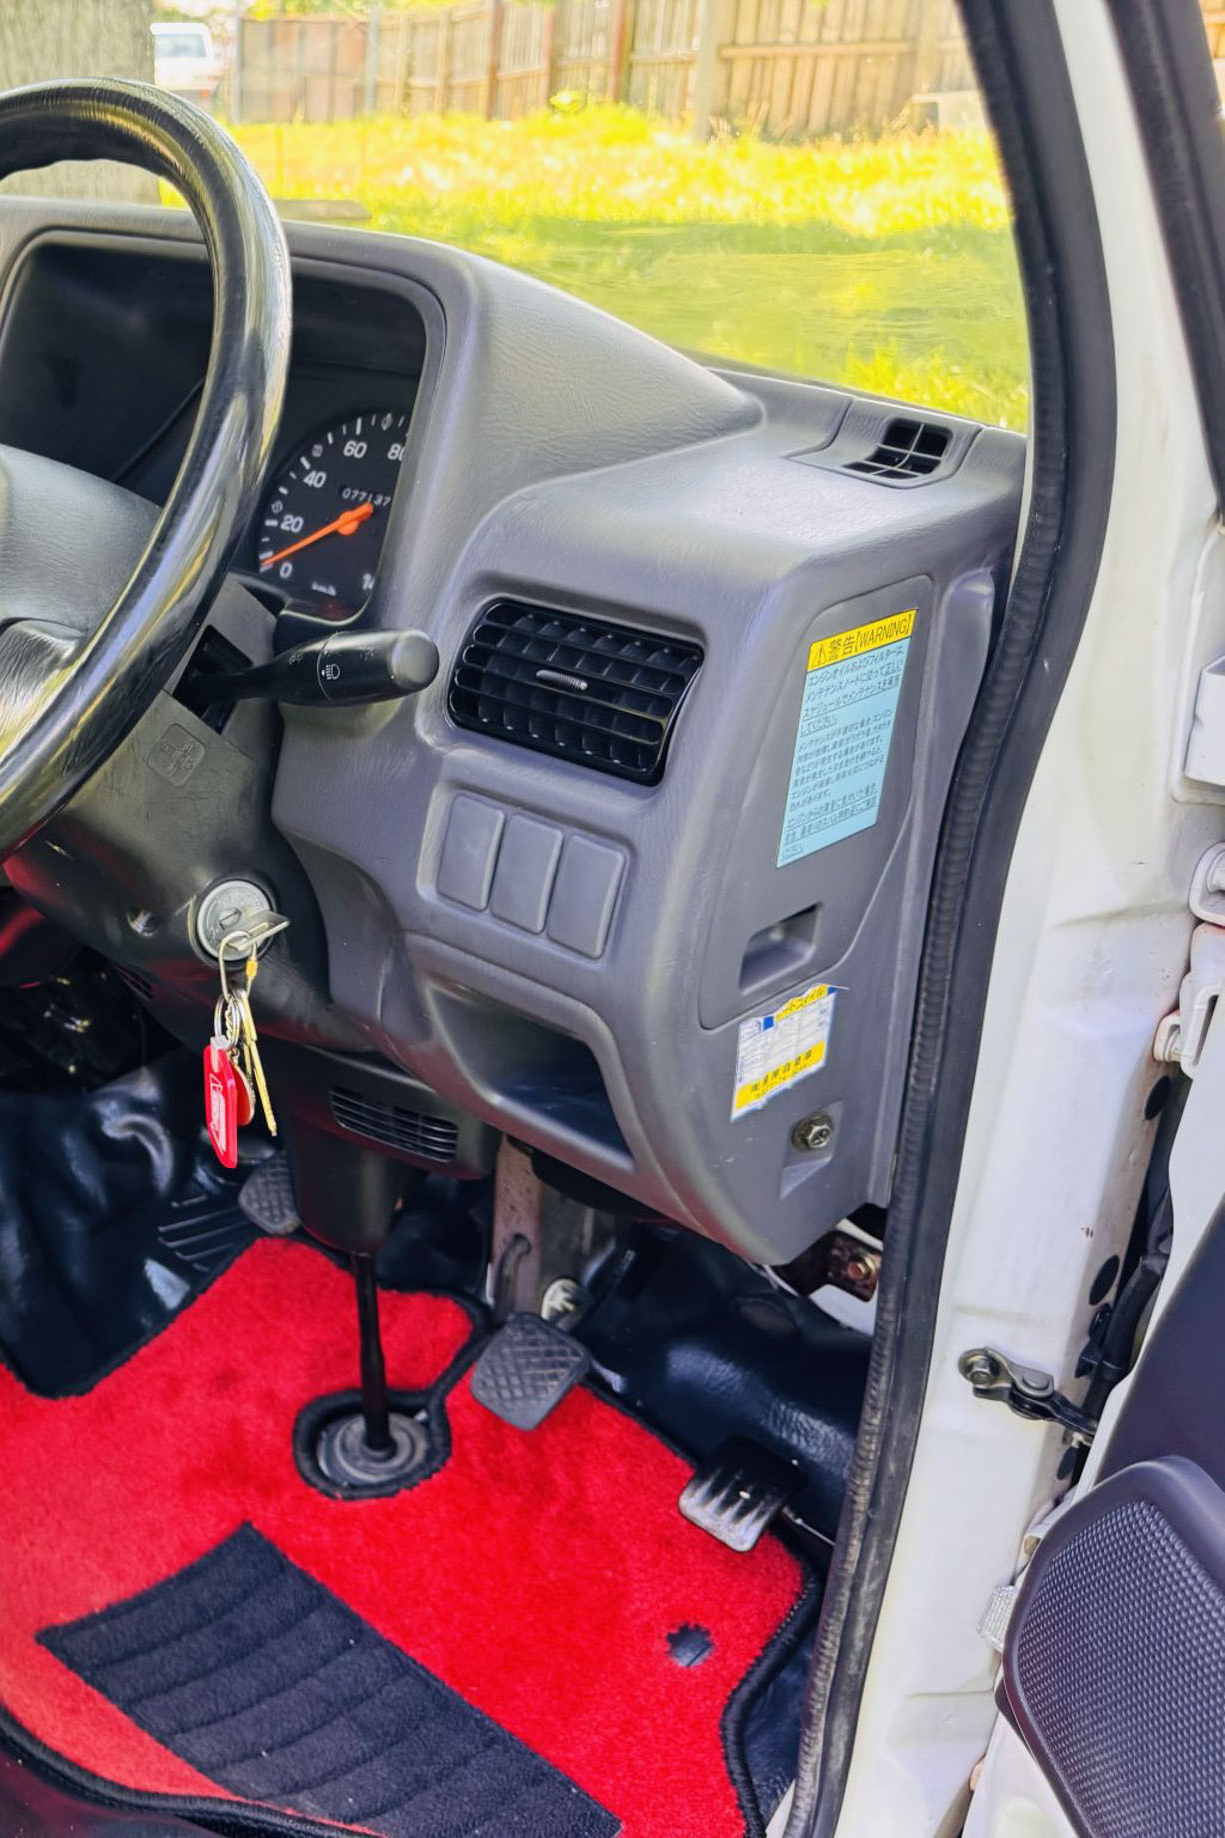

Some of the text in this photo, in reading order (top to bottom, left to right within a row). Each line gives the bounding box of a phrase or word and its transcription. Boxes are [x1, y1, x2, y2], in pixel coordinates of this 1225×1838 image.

[343, 440, 368, 459] 60
[303, 470, 327, 488] 40
[280, 514, 304, 533] 20
[279, 562, 293, 578] 0
